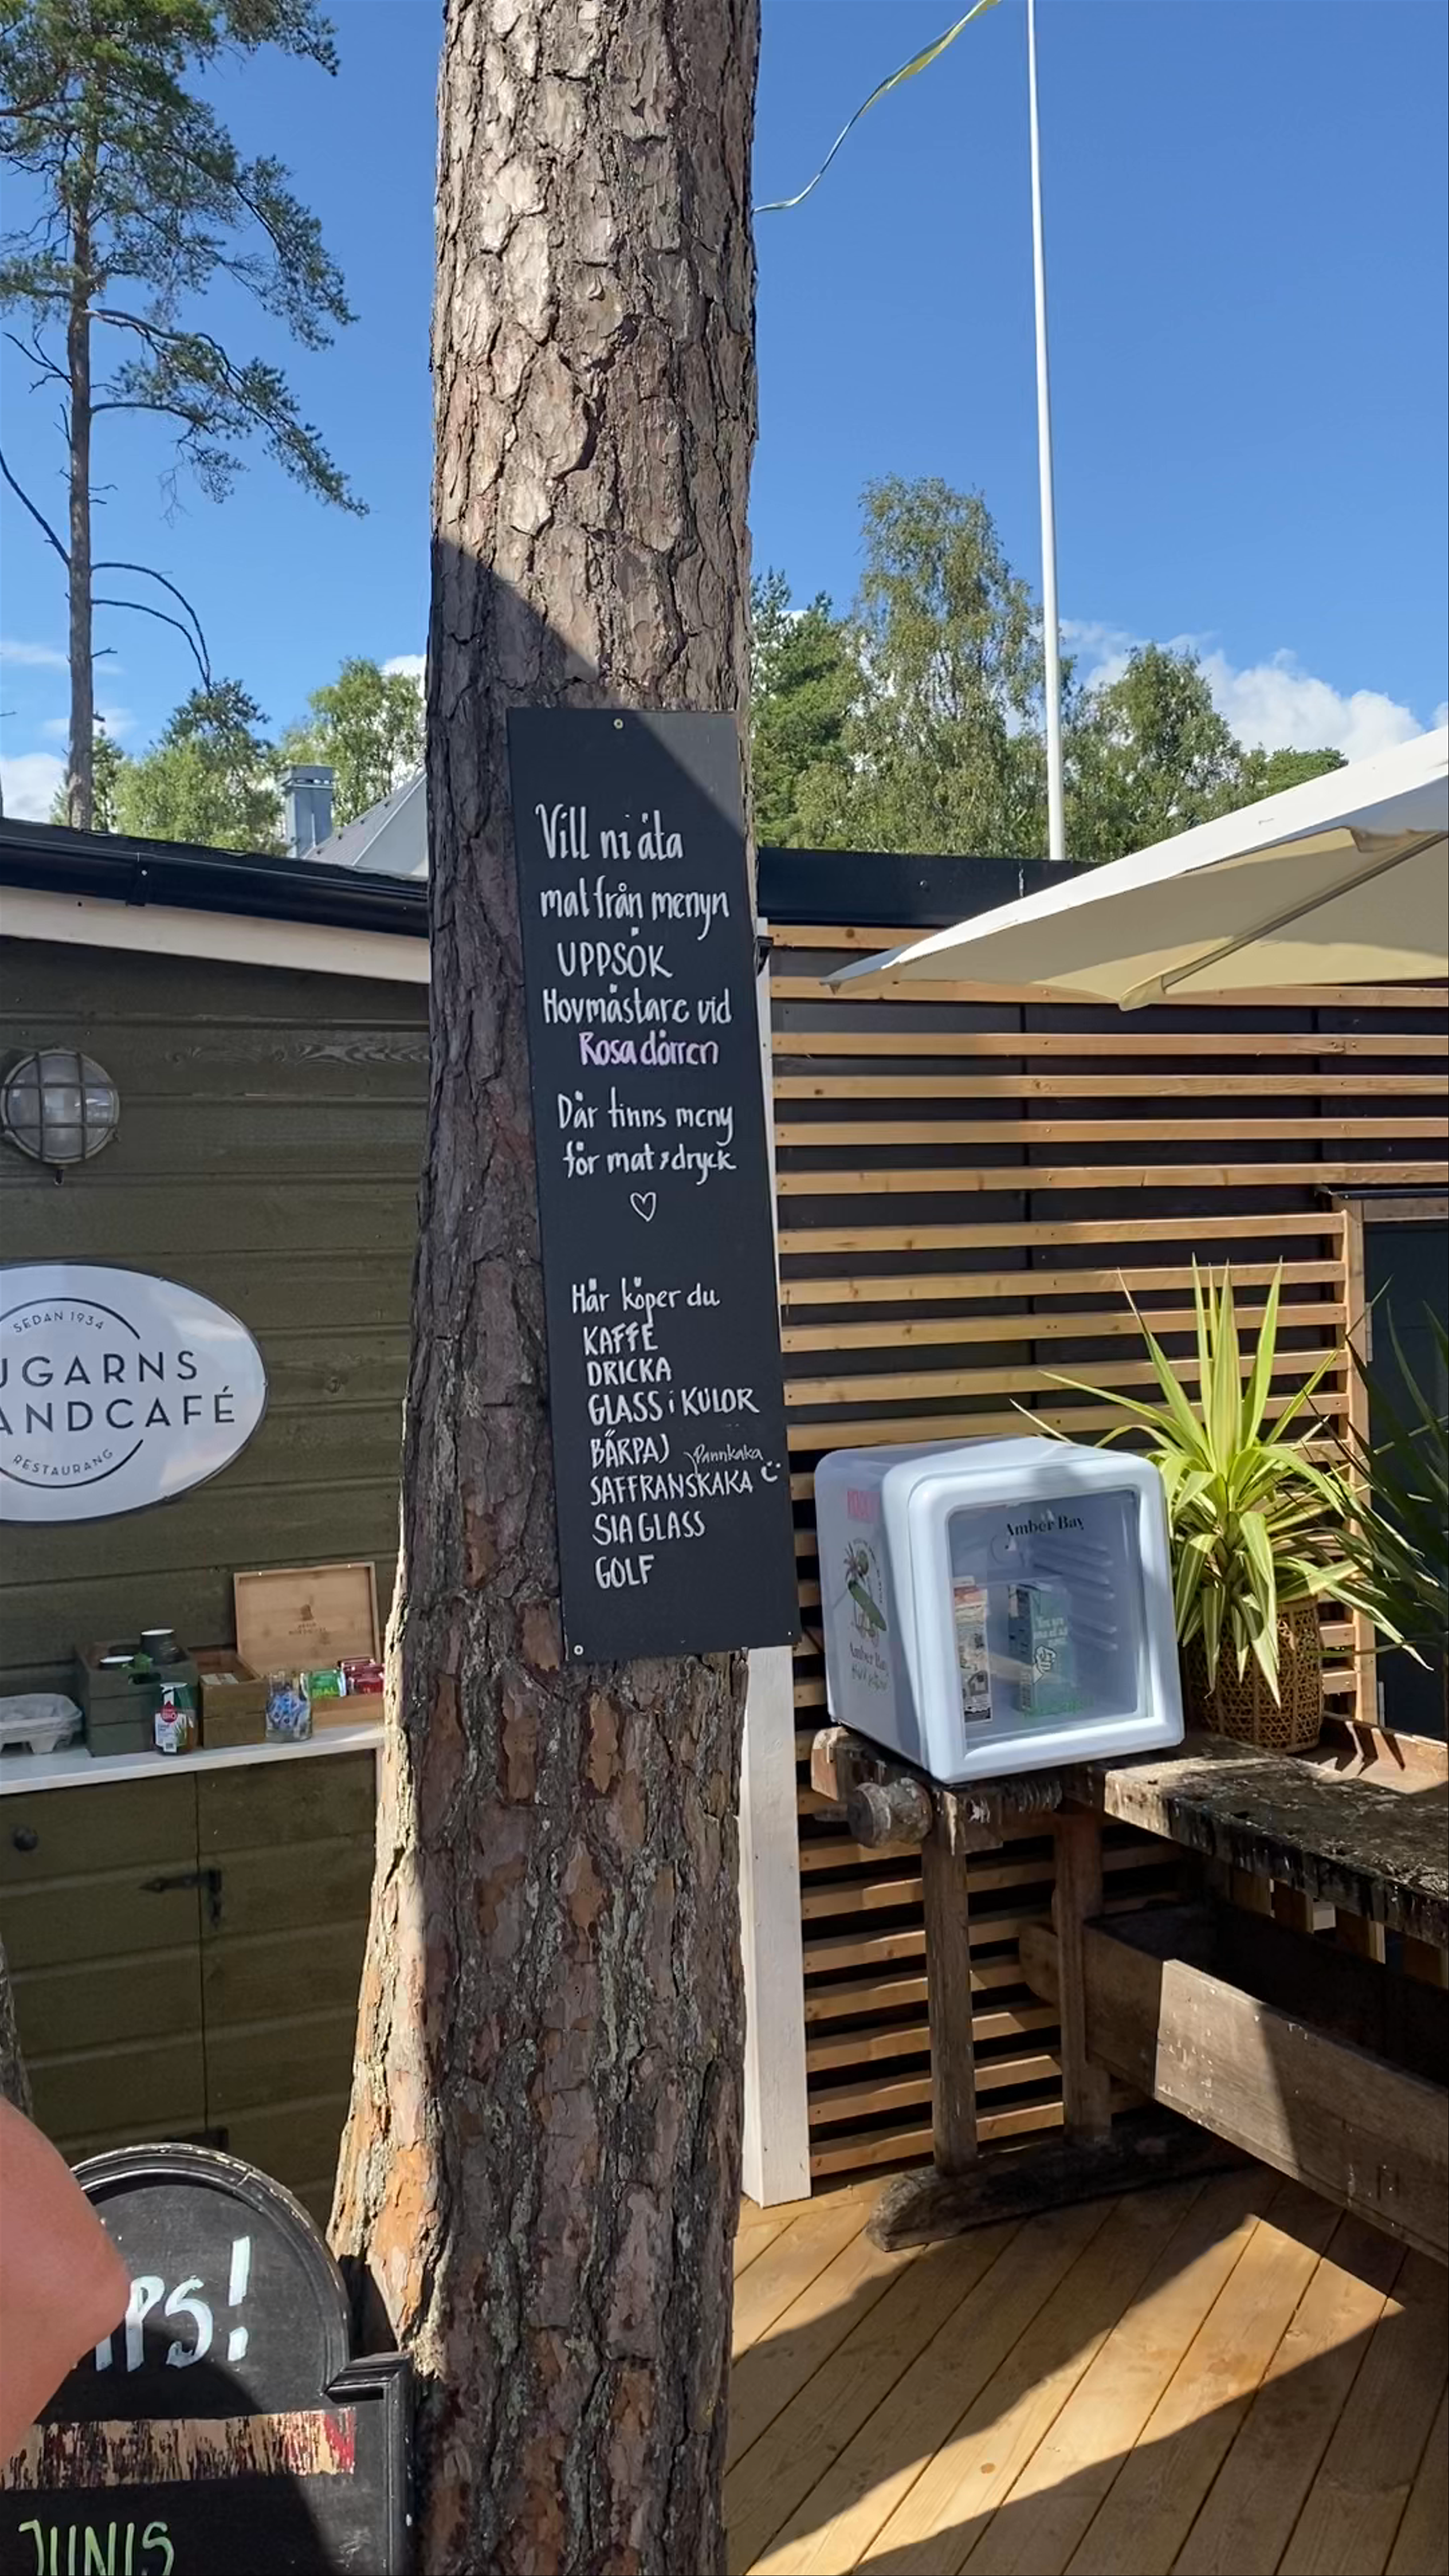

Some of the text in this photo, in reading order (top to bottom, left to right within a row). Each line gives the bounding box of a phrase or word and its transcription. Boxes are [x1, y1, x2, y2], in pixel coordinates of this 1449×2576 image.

[535, 804, 683, 860] Vill ni äta
[541, 875, 729, 940] mat från menyn
[558, 927, 672, 978] UPPSÖK
[543, 984, 731, 1024] Hovmästare vid
[579, 1032, 637, 1065] Rosa
[558, 1091, 598, 1128] Där
[676, 1106, 733, 1146] meny
[563, 1140, 600, 1178] för
[607, 1143, 655, 1173] mat
[671, 1143, 737, 1185] dryck
[572, 1277, 720, 1323] Här köper du
[13, 1311, 104, 1333] SEDAN 1934
[584, 1321, 658, 1355] KAFFE
[587, 1357, 671, 1386] DRICKA
[588, 1391, 662, 1425] GLASS
[681, 1387, 760, 1415] KULOR
[13, 1449, 113, 1475] RESTAURANG
[591, 1429, 669, 1469] BÄRPAJ
[693, 1444, 763, 1464] Pannkaka
[590, 1470, 753, 1506] SAFFRANSKAKA
[638, 1511, 705, 1541] GLASS
[1006, 1515, 1085, 1536] Amber Bay
[596, 1555, 654, 1588] GOLF
[95, 2236, 250, 2372] PS!
